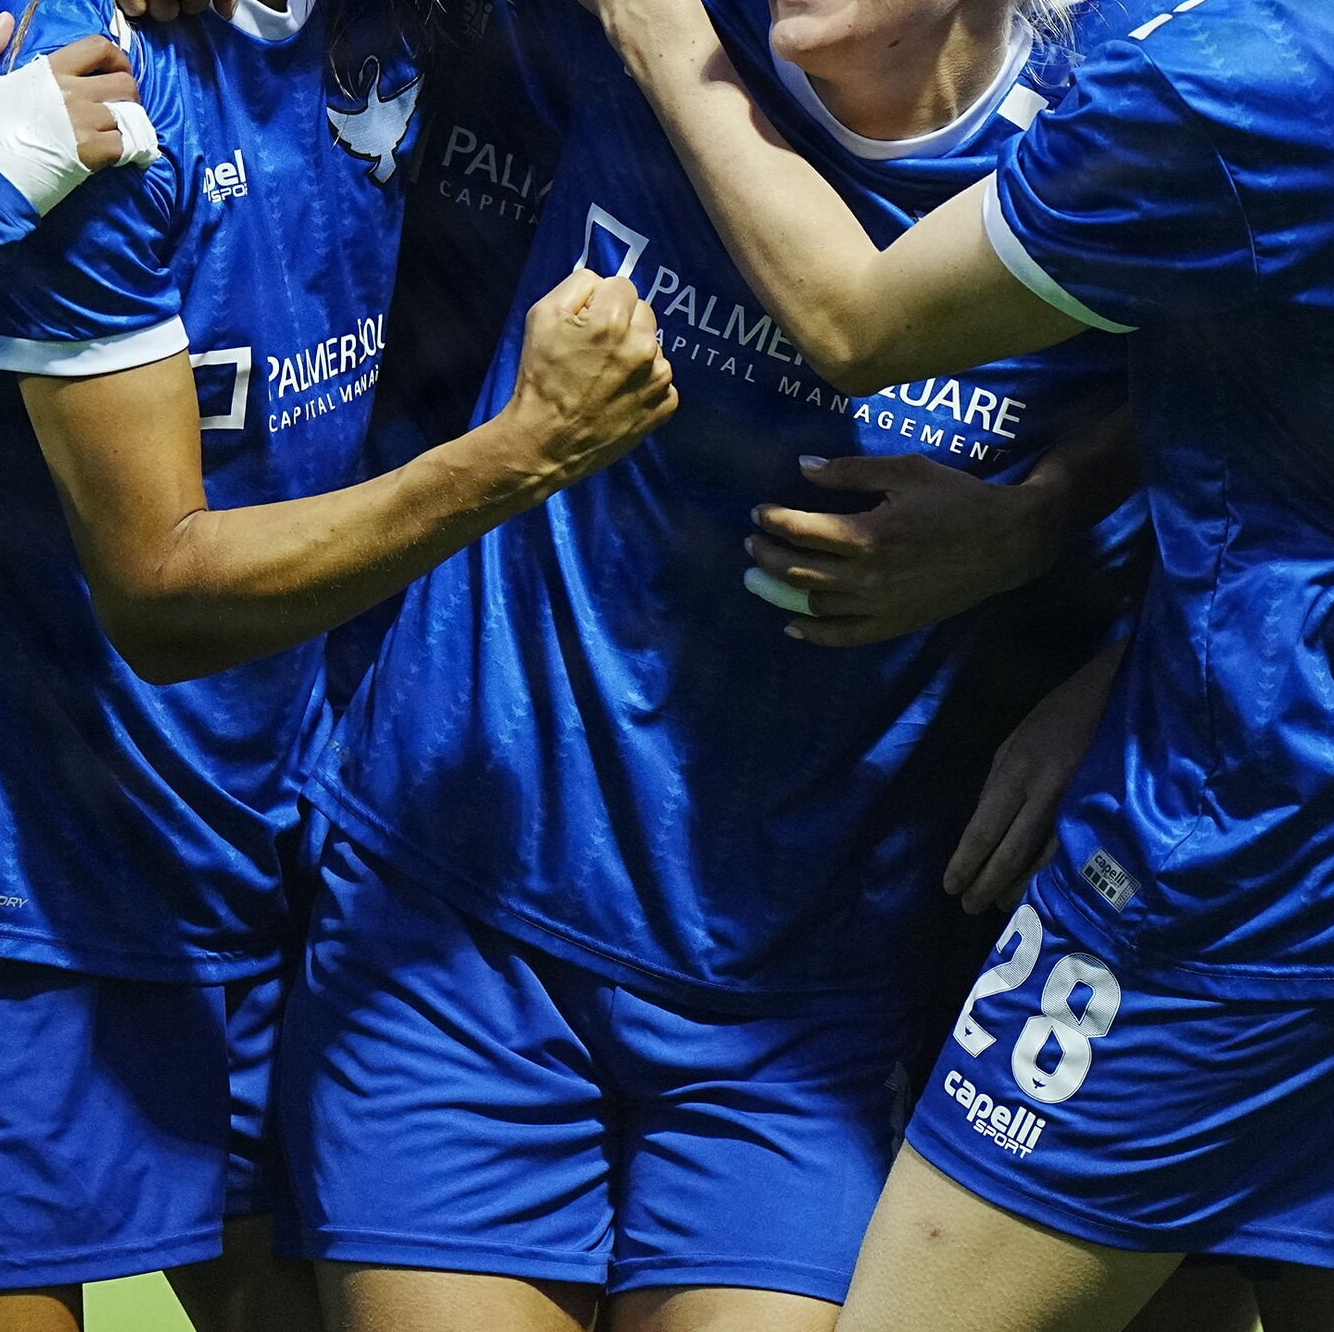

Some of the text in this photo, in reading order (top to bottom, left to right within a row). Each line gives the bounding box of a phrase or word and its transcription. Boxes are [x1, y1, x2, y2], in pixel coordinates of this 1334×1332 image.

[210, 183, 248, 204] SPO
[645, 265, 804, 367] PALME
[268, 364, 379, 433] CAPITAL MANA
[655, 327, 1011, 464] APITAL MANAGEMENT
[1094, 854, 1128, 886] capelli
[952, 904, 1122, 1104] 28
[943, 1070, 1047, 1150] capelli
[972, 1121, 1033, 1159] SPORT
